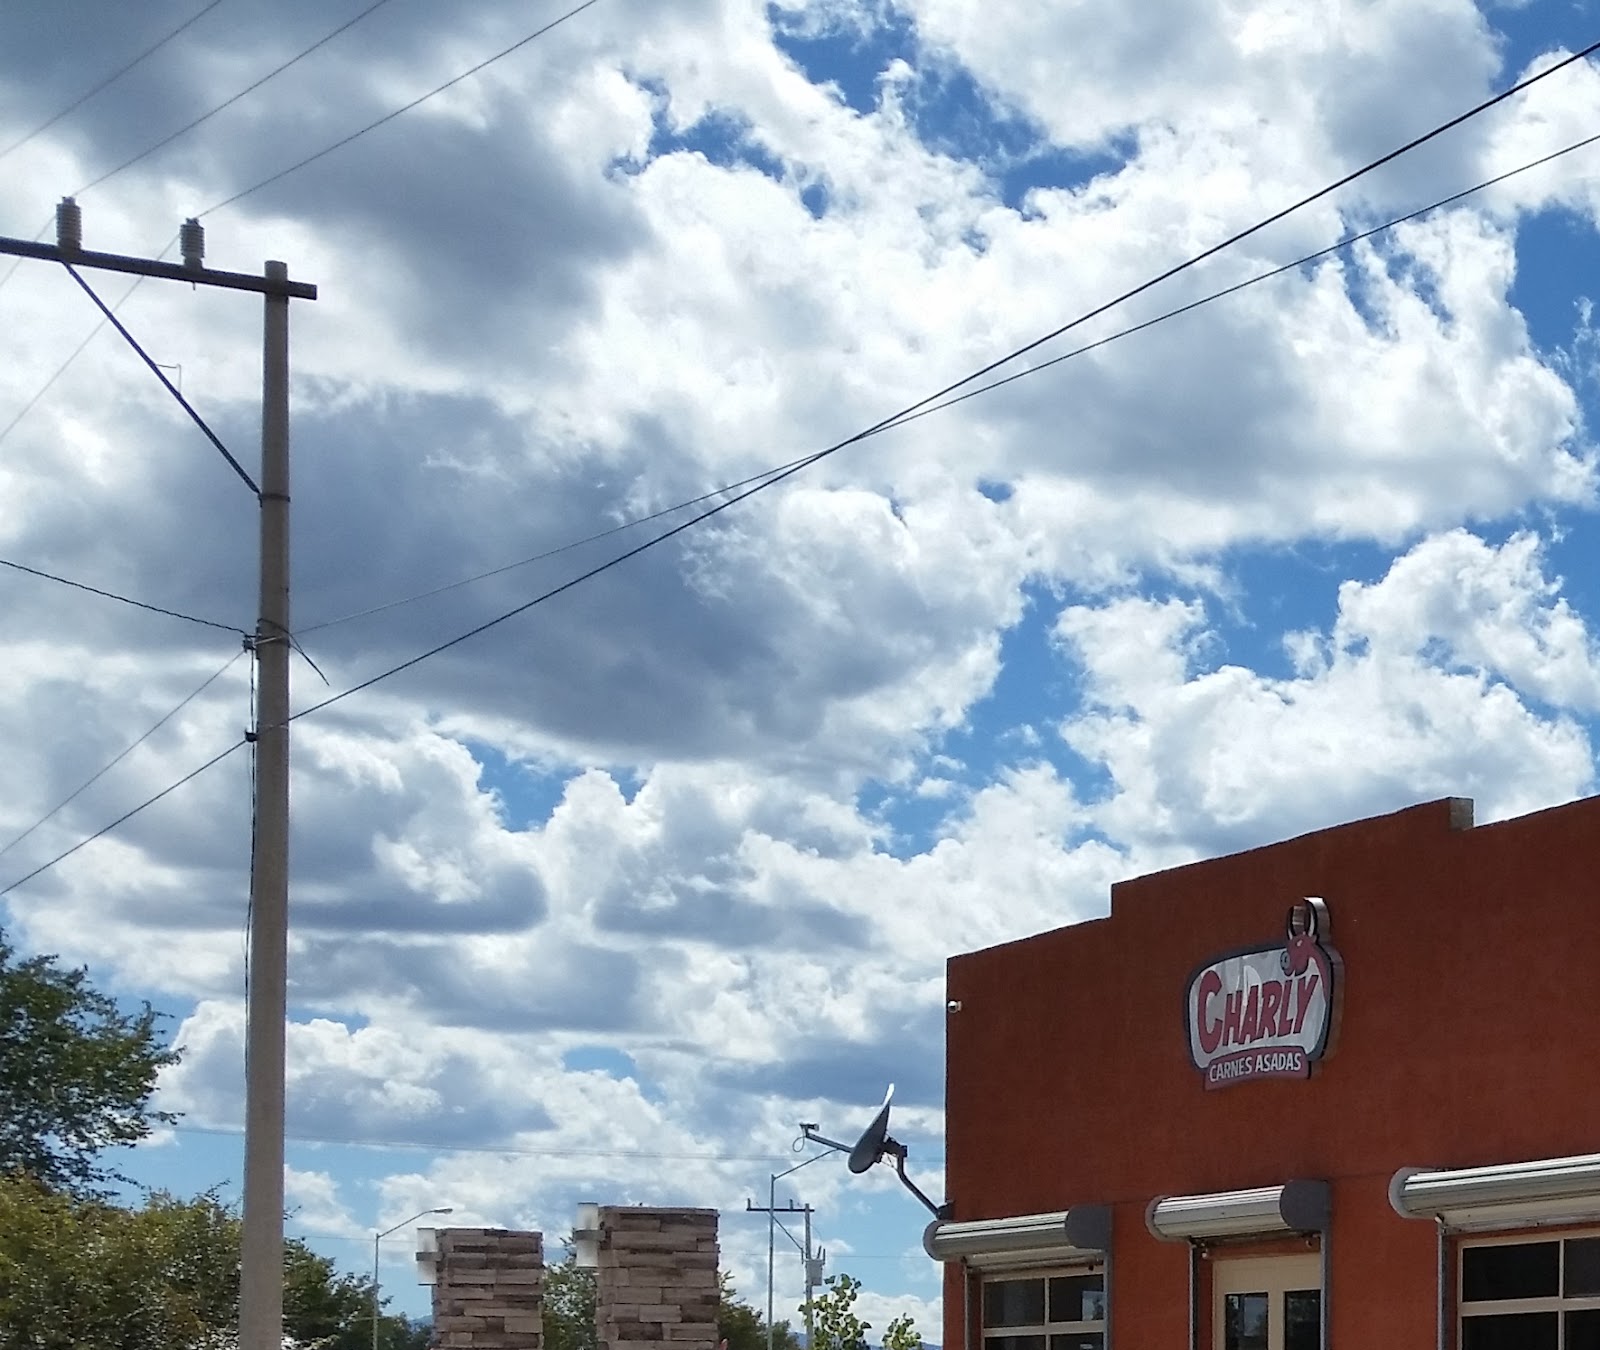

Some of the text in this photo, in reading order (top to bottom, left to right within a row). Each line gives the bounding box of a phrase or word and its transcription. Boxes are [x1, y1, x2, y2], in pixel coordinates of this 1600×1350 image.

[1198, 970, 1319, 1053] CHARLY
[1209, 1052, 1302, 1082] CARNES ASADAS
